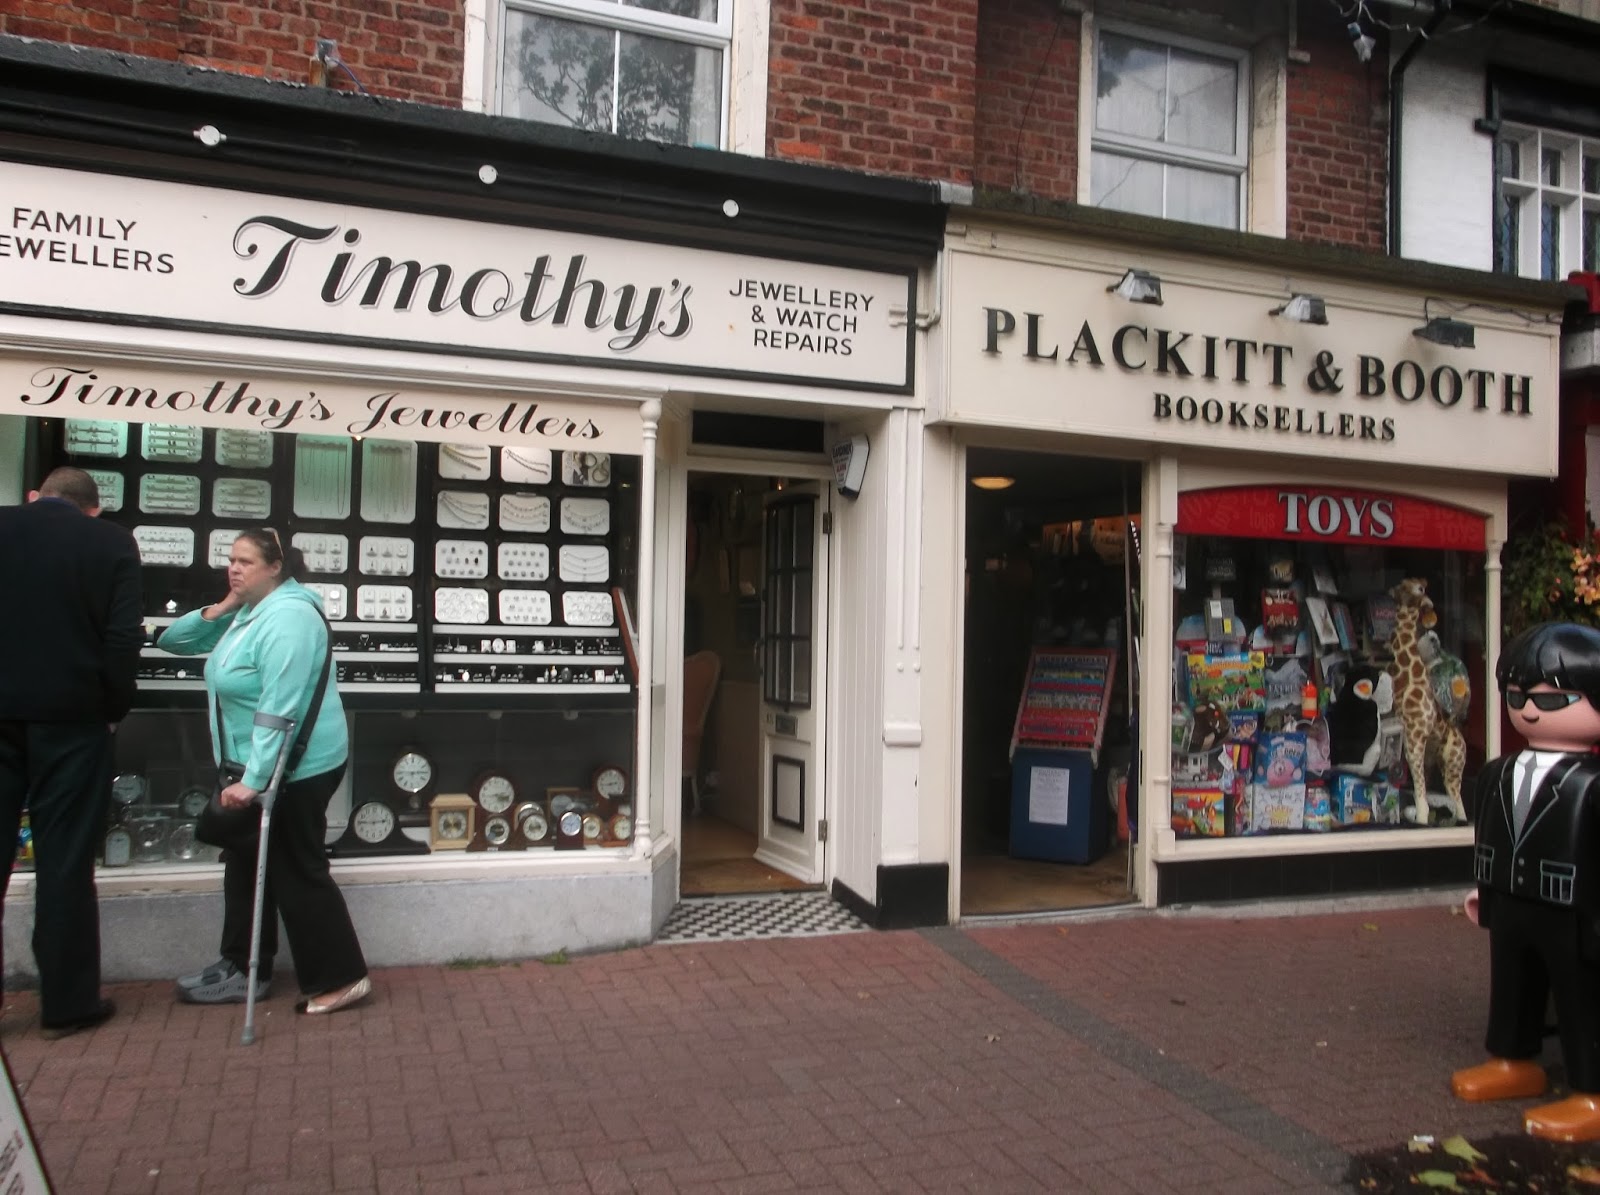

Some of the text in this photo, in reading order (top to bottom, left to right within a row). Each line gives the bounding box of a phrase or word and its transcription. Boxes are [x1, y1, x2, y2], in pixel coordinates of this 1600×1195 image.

[14, 207, 136, 241] FAMILY
[233, 215, 693, 350] Timothy's
[729, 280, 875, 313] JEWELLERY
[752, 306, 858, 334] & WATCH
[754, 328, 853, 356] REPAIRS
[983, 305, 1532, 417] PLACKITT & BOOTH
[20, 366, 604, 439] Timothy's Jewellers
[1154, 392, 1395, 441] BOOKSELLERS
[1278, 492, 1394, 539] TOYS
